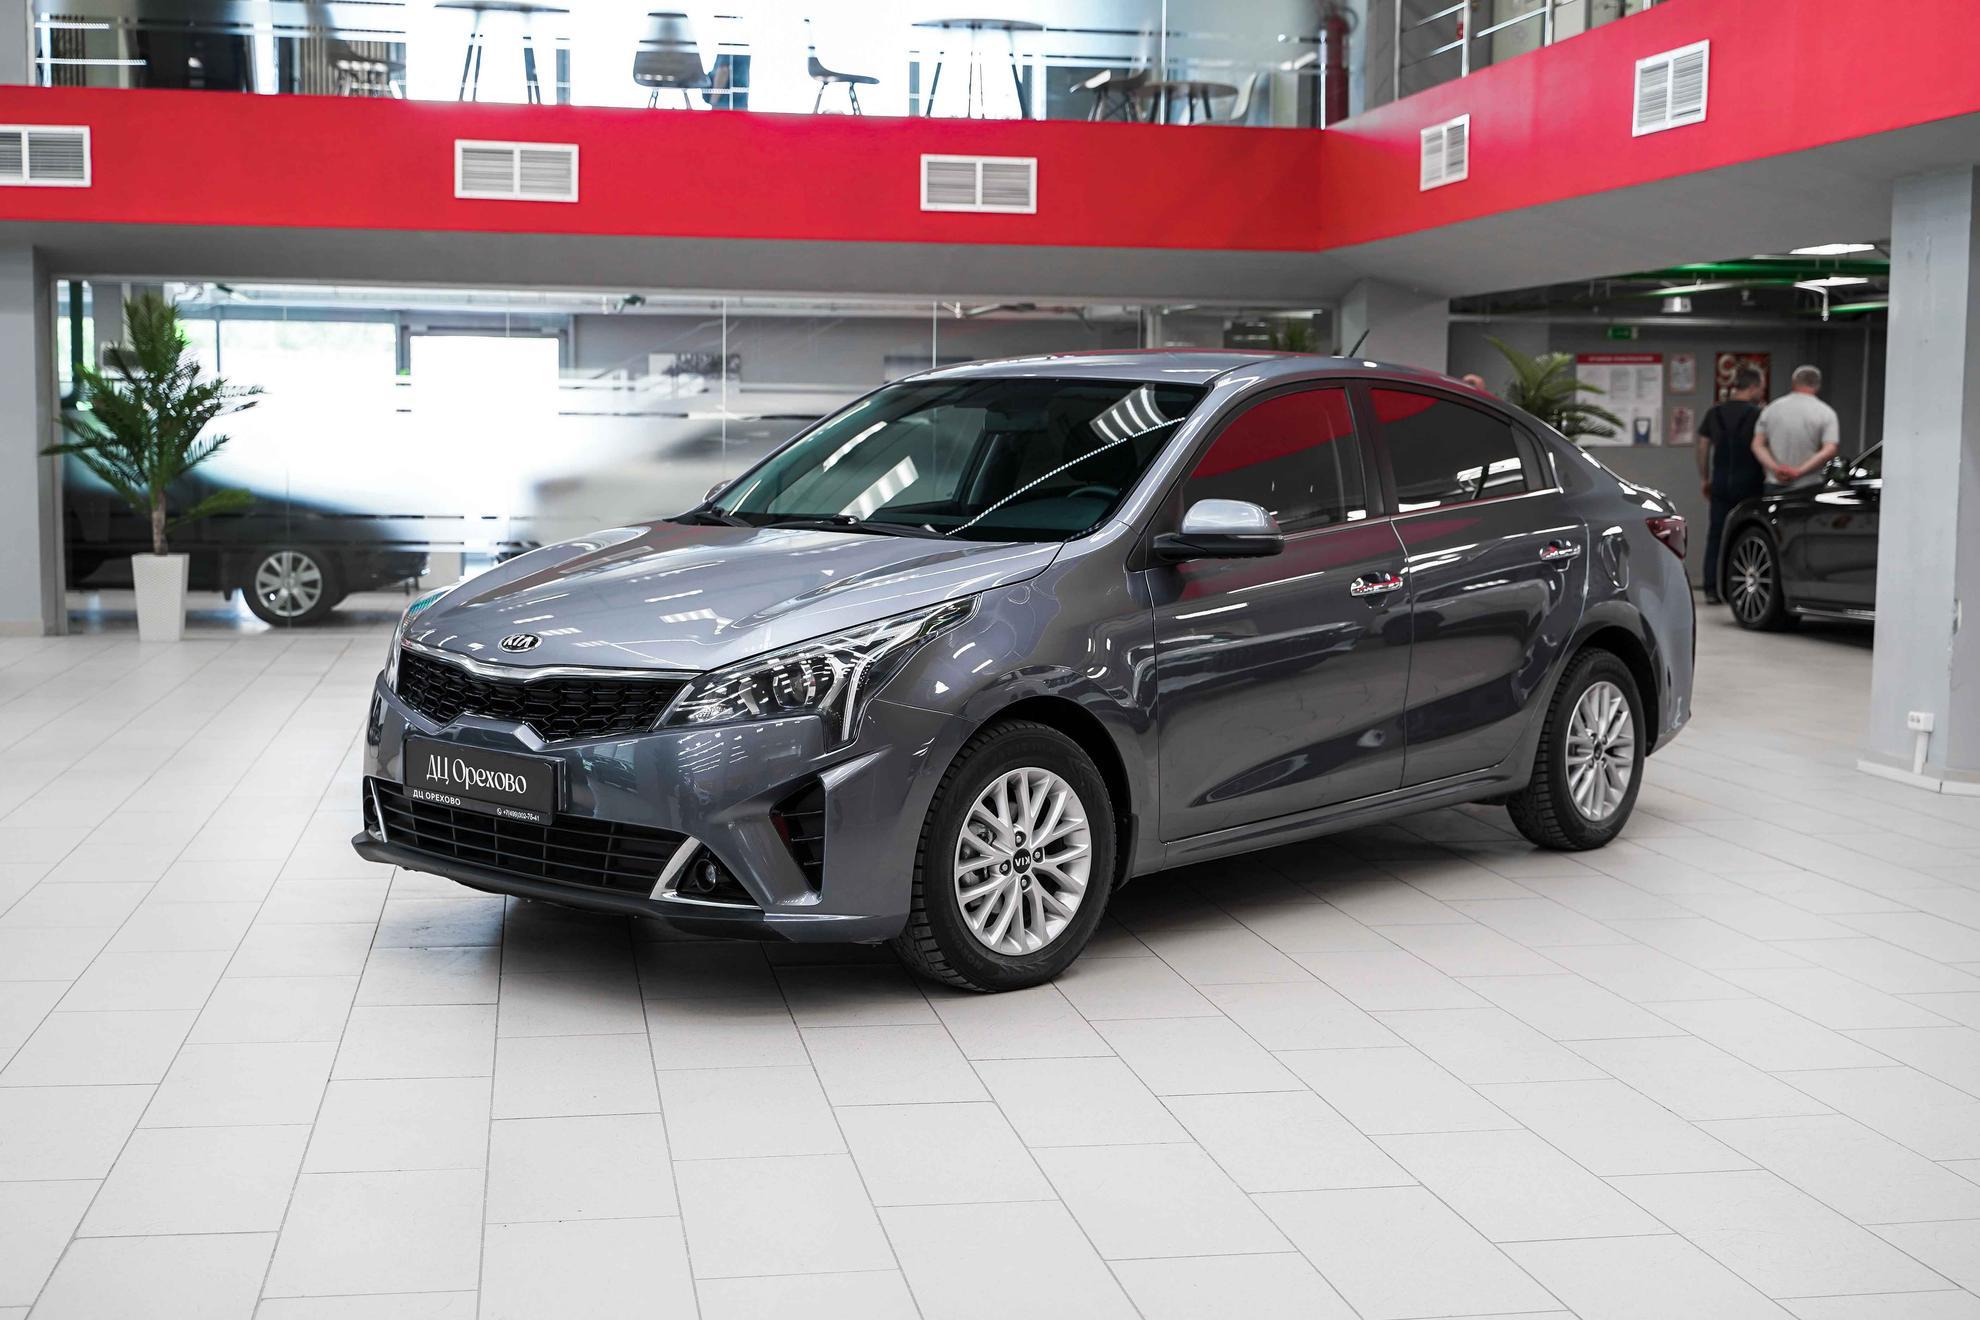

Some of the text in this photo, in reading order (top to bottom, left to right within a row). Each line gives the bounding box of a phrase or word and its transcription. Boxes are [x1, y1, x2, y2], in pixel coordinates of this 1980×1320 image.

[503, 635, 534, 648] KIA
[426, 754, 527, 794] ДЦ Орехово
[412, 789, 461, 806] ДЦ ОРЕХОВО
[1014, 855, 1031, 867] KIA
